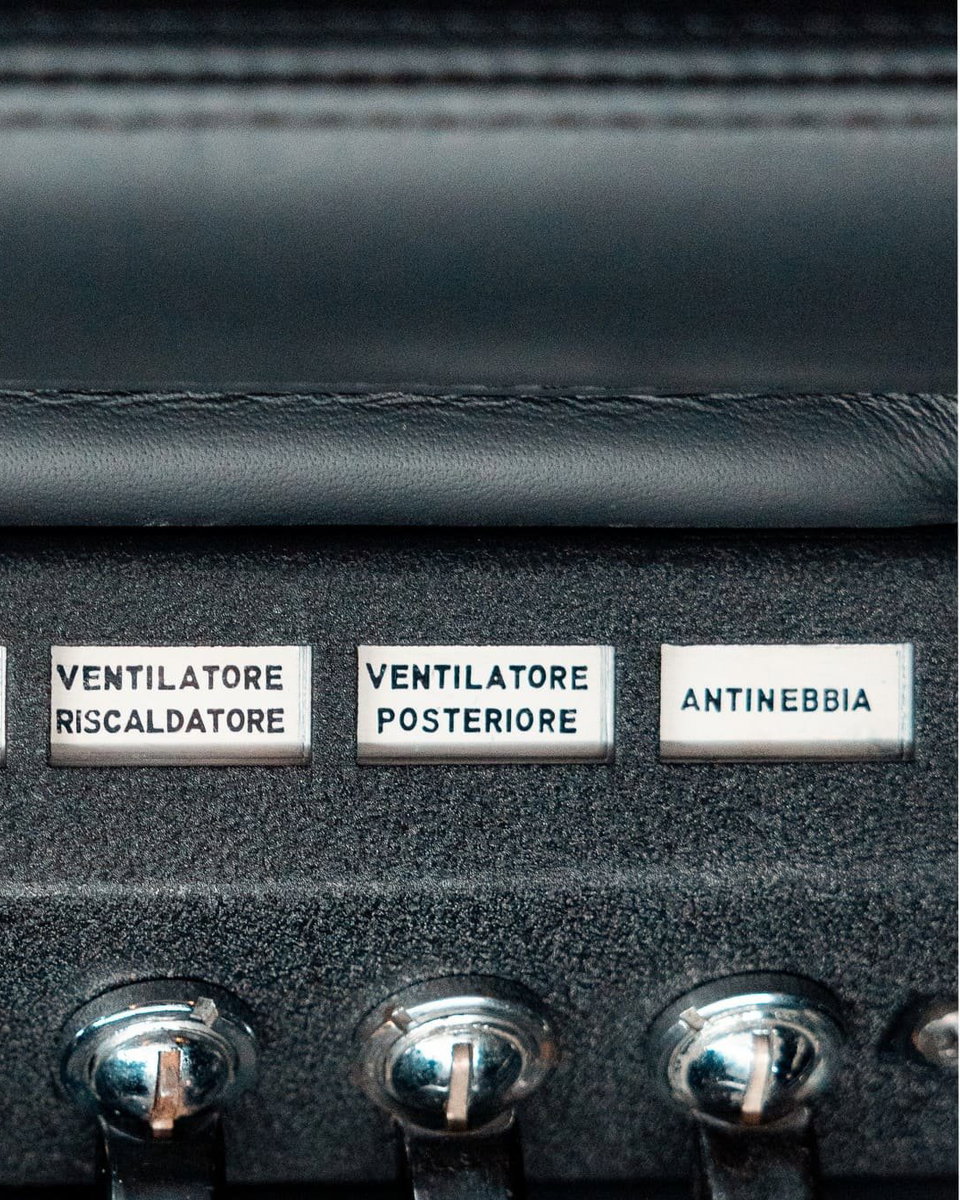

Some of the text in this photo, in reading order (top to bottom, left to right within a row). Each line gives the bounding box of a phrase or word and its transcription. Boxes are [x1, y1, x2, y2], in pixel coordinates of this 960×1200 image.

[55, 664, 284, 691] VENTILATORE
[366, 663, 589, 690] VENTILATORE
[680, 687, 872, 713] ANTINEBBIA
[55, 708, 286, 734] RISCALDATORE
[377, 707, 578, 734] POSTERIORE
